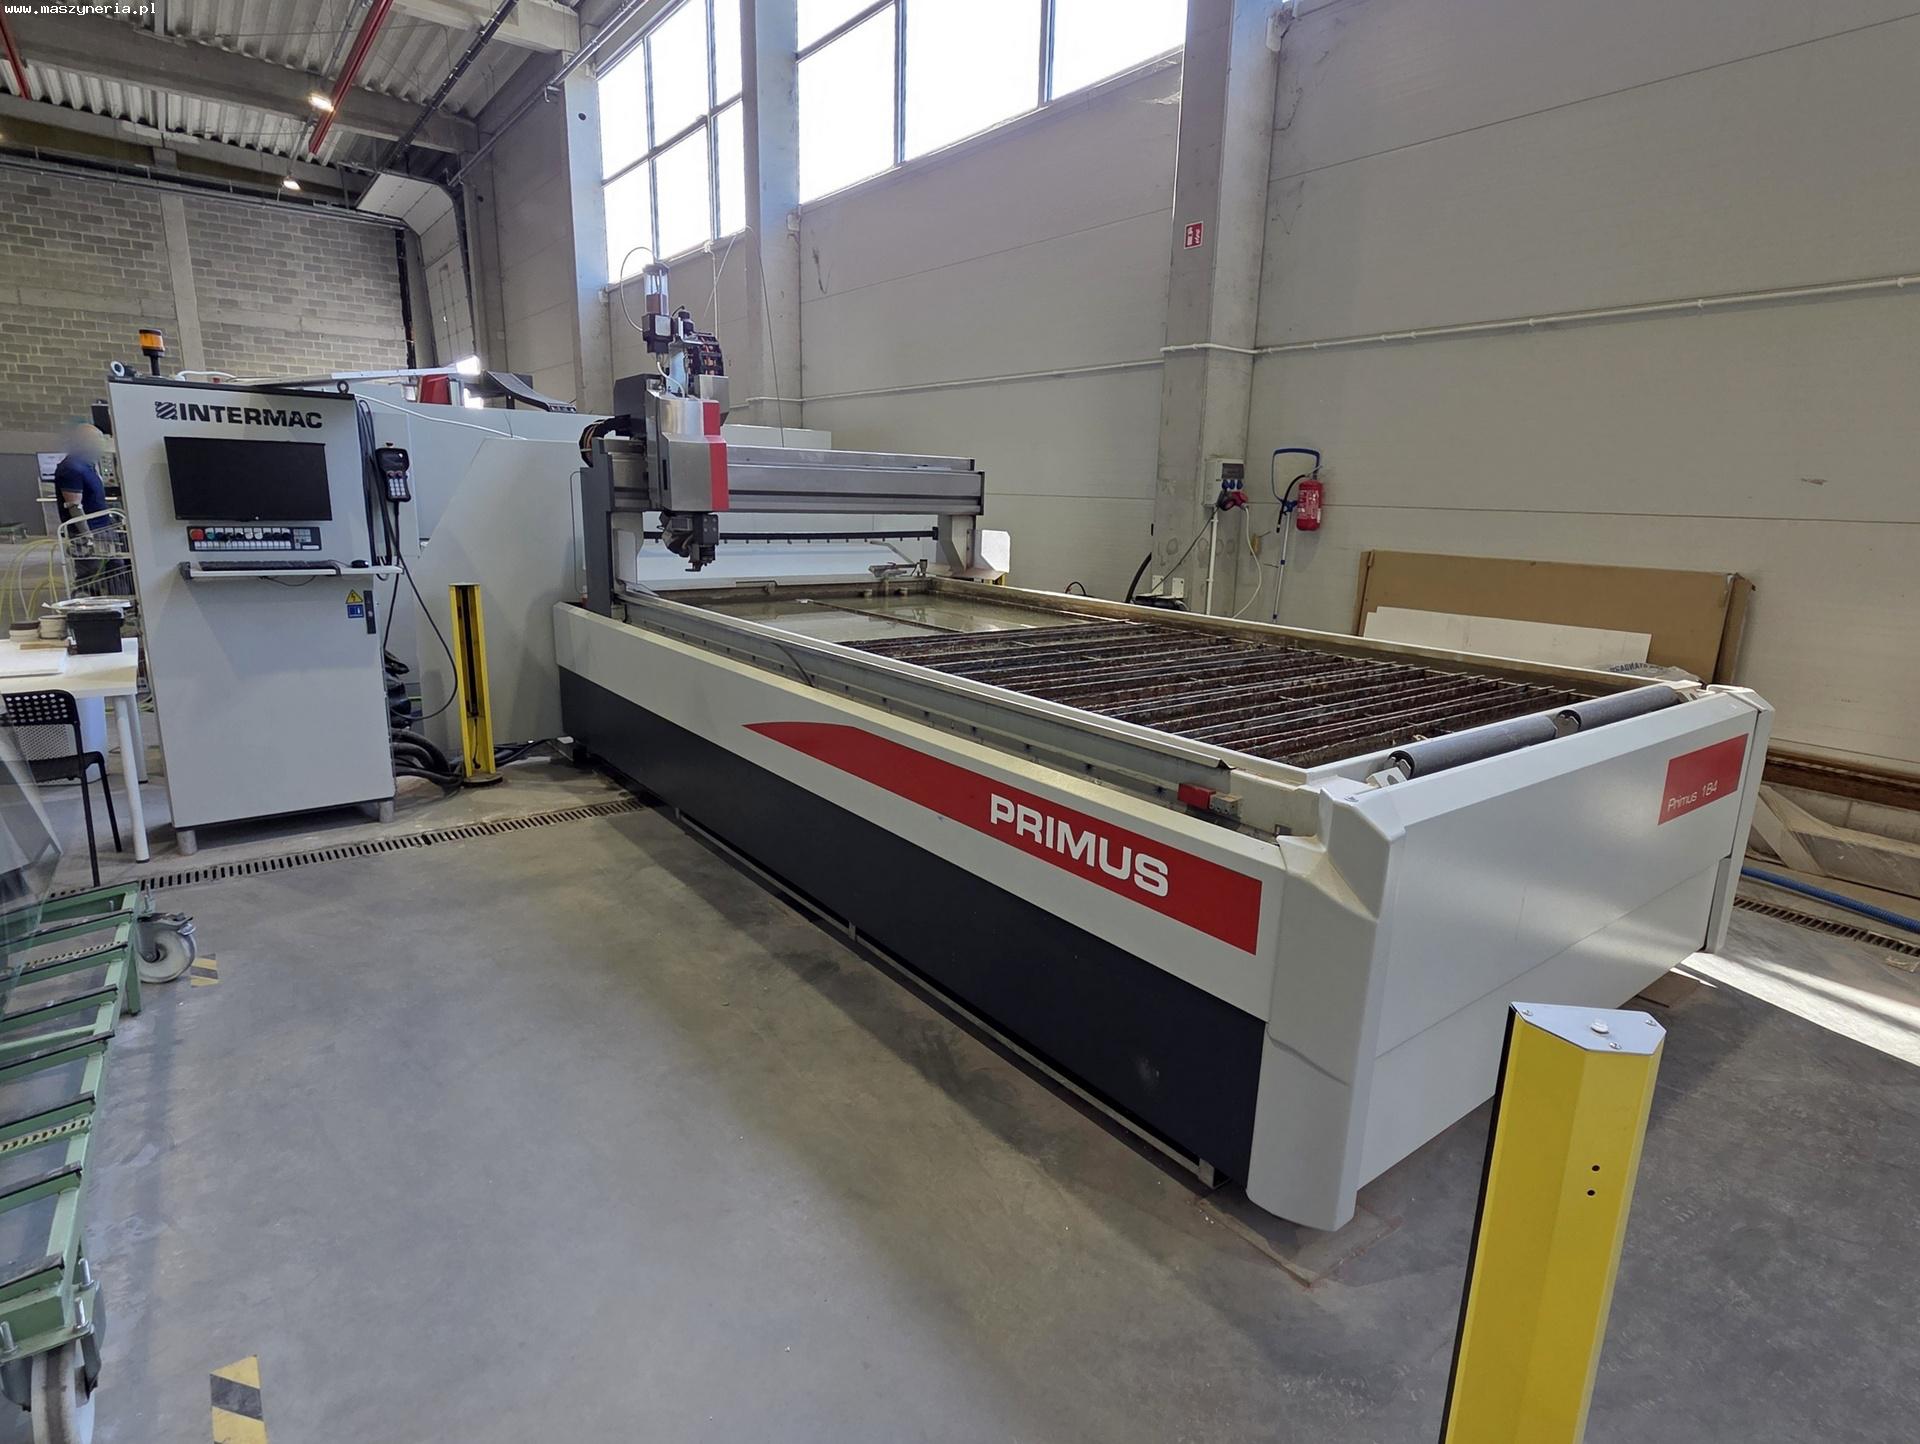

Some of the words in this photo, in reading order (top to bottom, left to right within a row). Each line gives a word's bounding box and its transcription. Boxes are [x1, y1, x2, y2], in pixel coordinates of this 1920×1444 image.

[179, 402, 323, 429] INTERMAC
[1667, 791, 1698, 812] Primus
[990, 793, 1169, 897] PRIMUS
